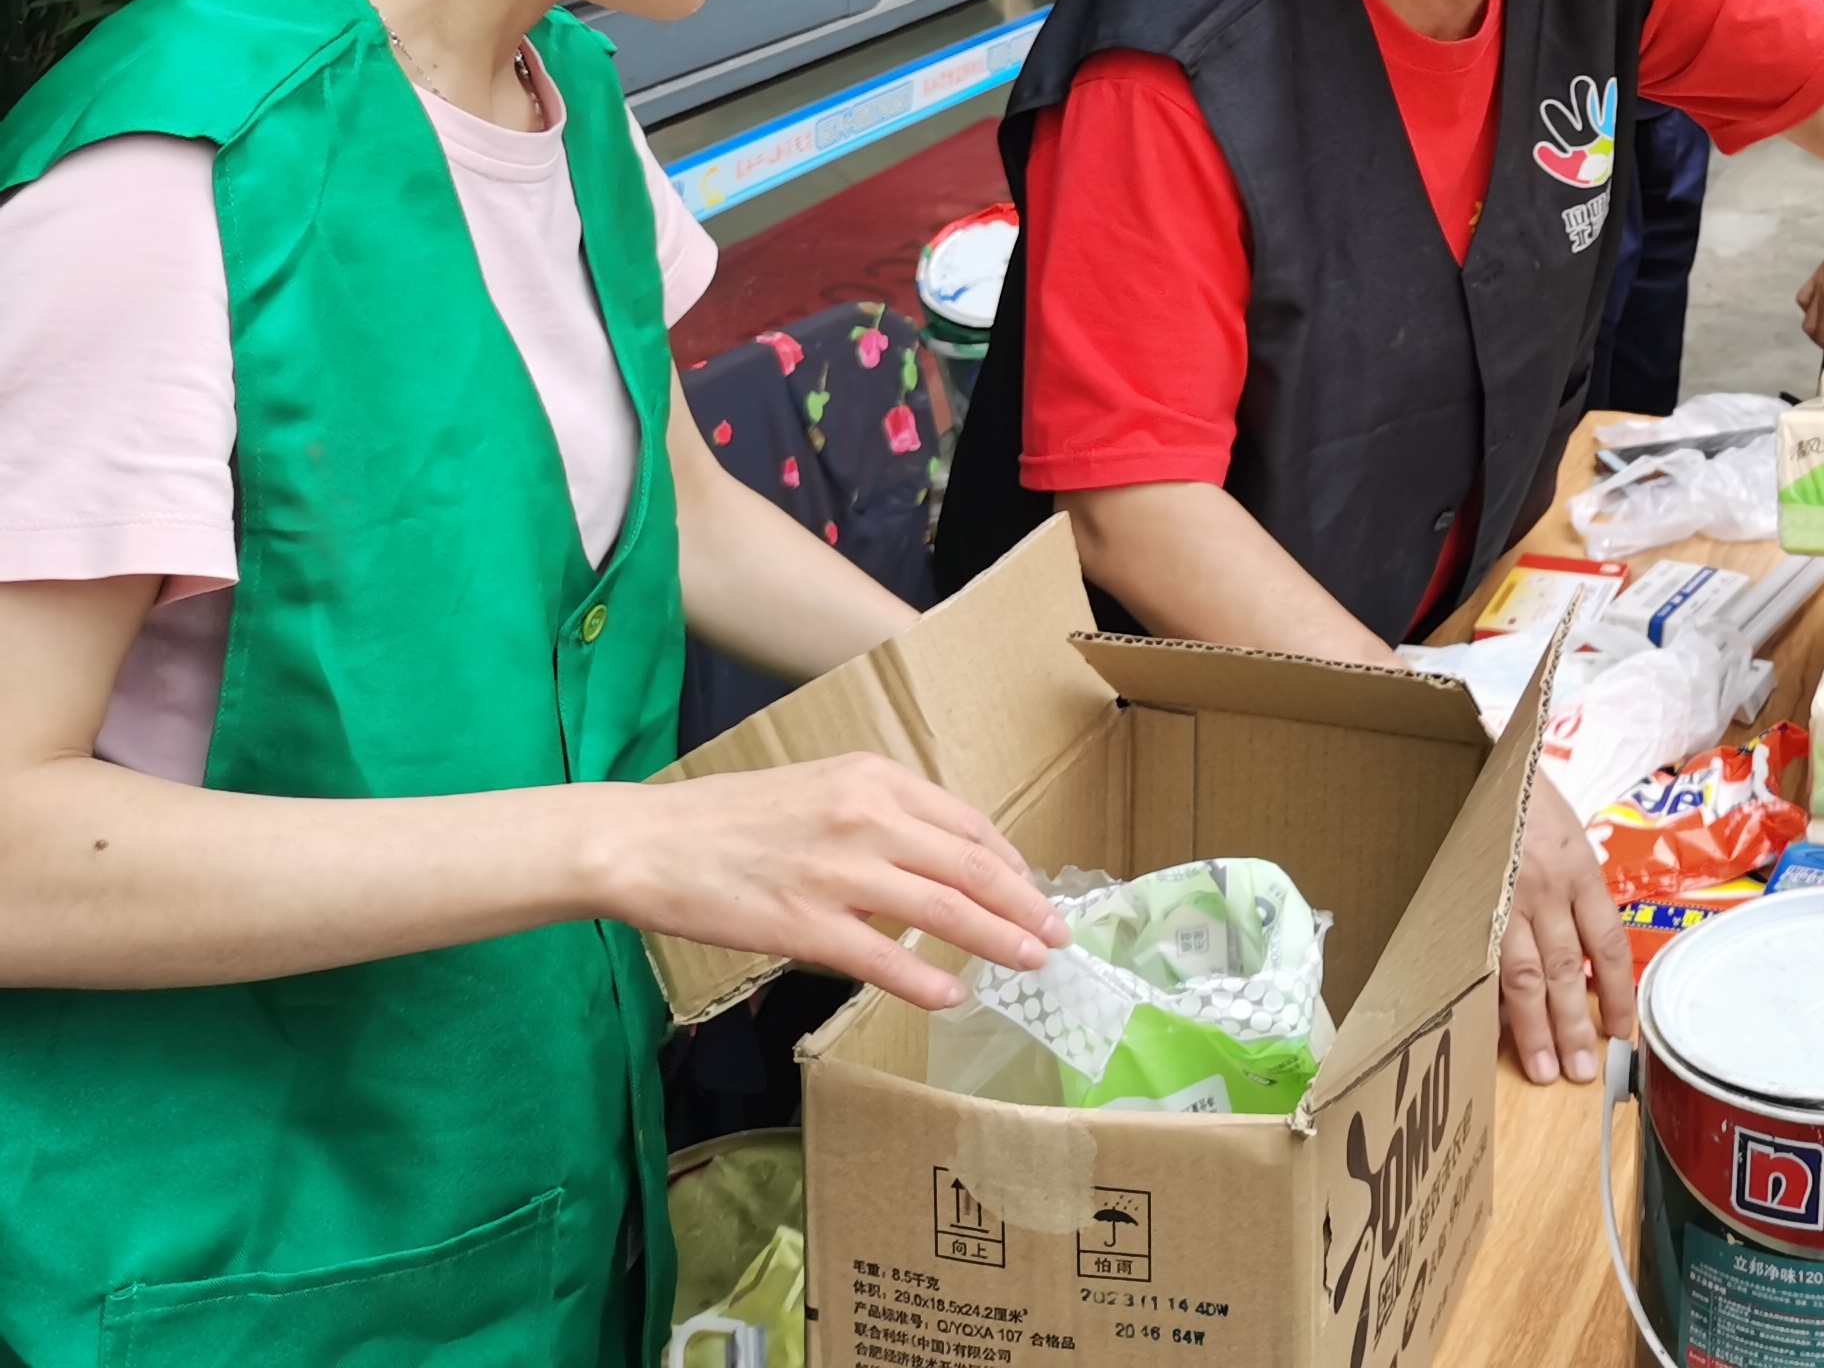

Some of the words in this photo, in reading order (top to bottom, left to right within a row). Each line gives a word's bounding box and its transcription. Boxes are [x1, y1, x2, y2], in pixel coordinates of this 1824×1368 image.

[1382, 1027, 1451, 1261] OMO
[951, 1239, 988, 1260] 向上
[1094, 1257, 1134, 1275] 怕雨
[1030, 1332, 1076, 1351] 合格品
